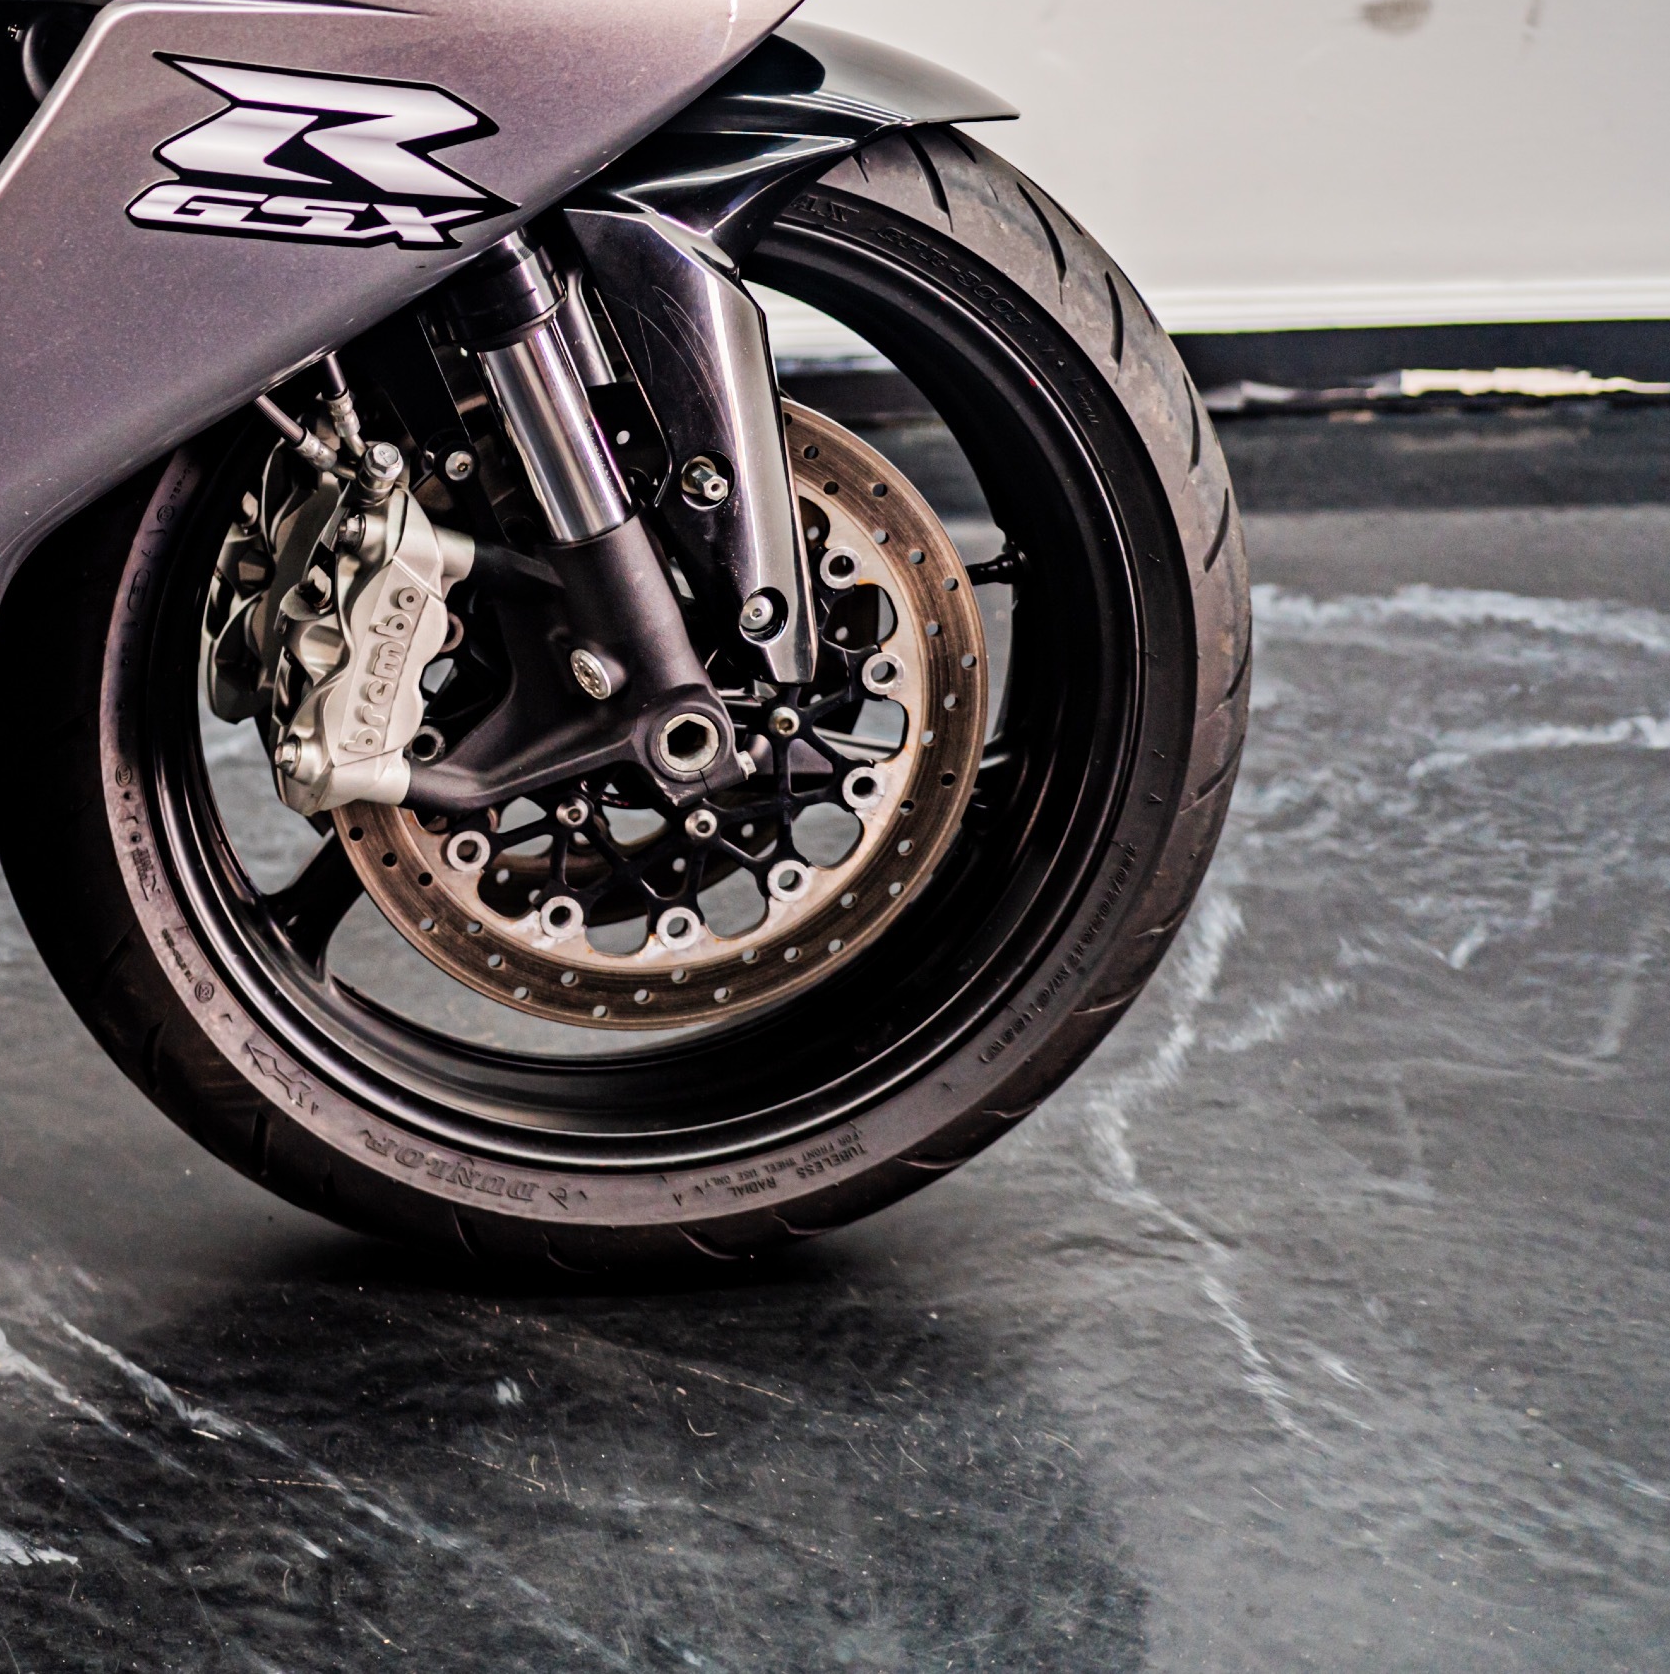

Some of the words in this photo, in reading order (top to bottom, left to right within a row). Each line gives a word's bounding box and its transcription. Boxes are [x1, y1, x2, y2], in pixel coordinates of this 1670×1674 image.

[152, 51, 516, 204] R
[125, 181, 485, 248] GSX
[341, 584, 425, 754] brembo
[360, 1128, 540, 1204] DUNLOP
[794, 1140, 869, 1182] TUBELESS
